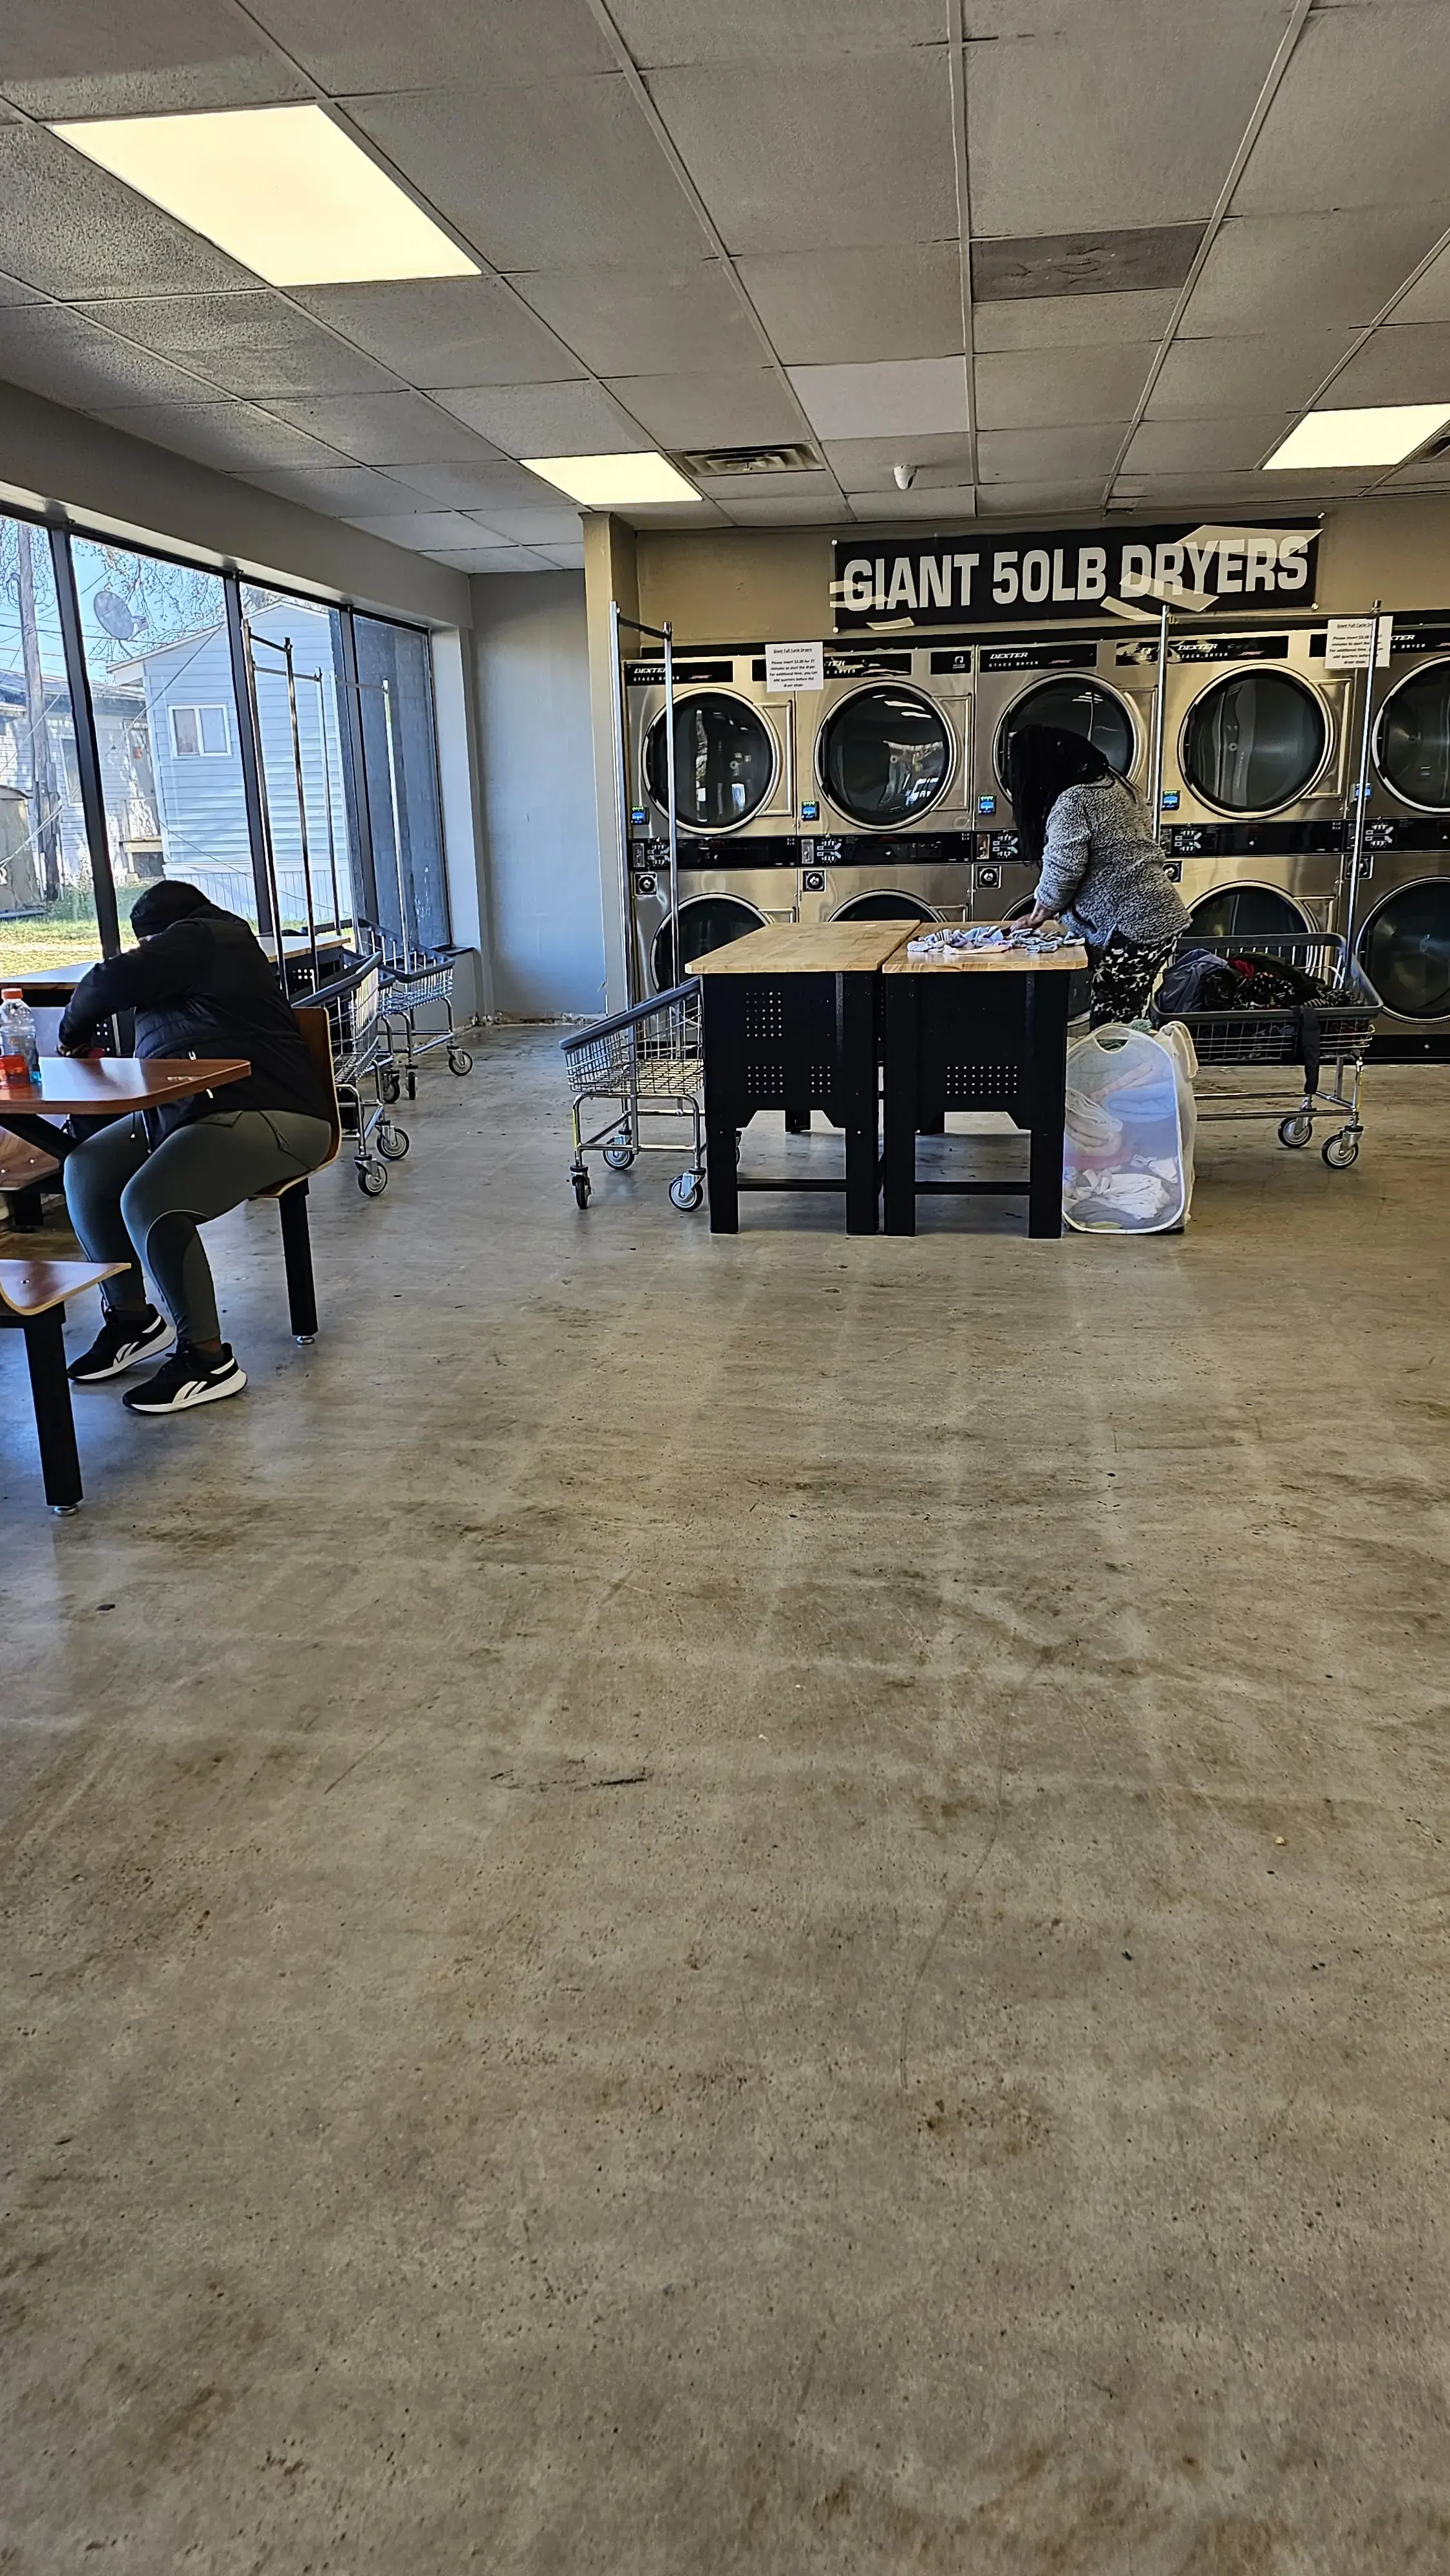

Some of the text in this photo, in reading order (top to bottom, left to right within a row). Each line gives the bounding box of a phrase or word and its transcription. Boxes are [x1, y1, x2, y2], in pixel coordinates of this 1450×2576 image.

[843, 536, 1309, 611] GIANT 50LB DRYERS
